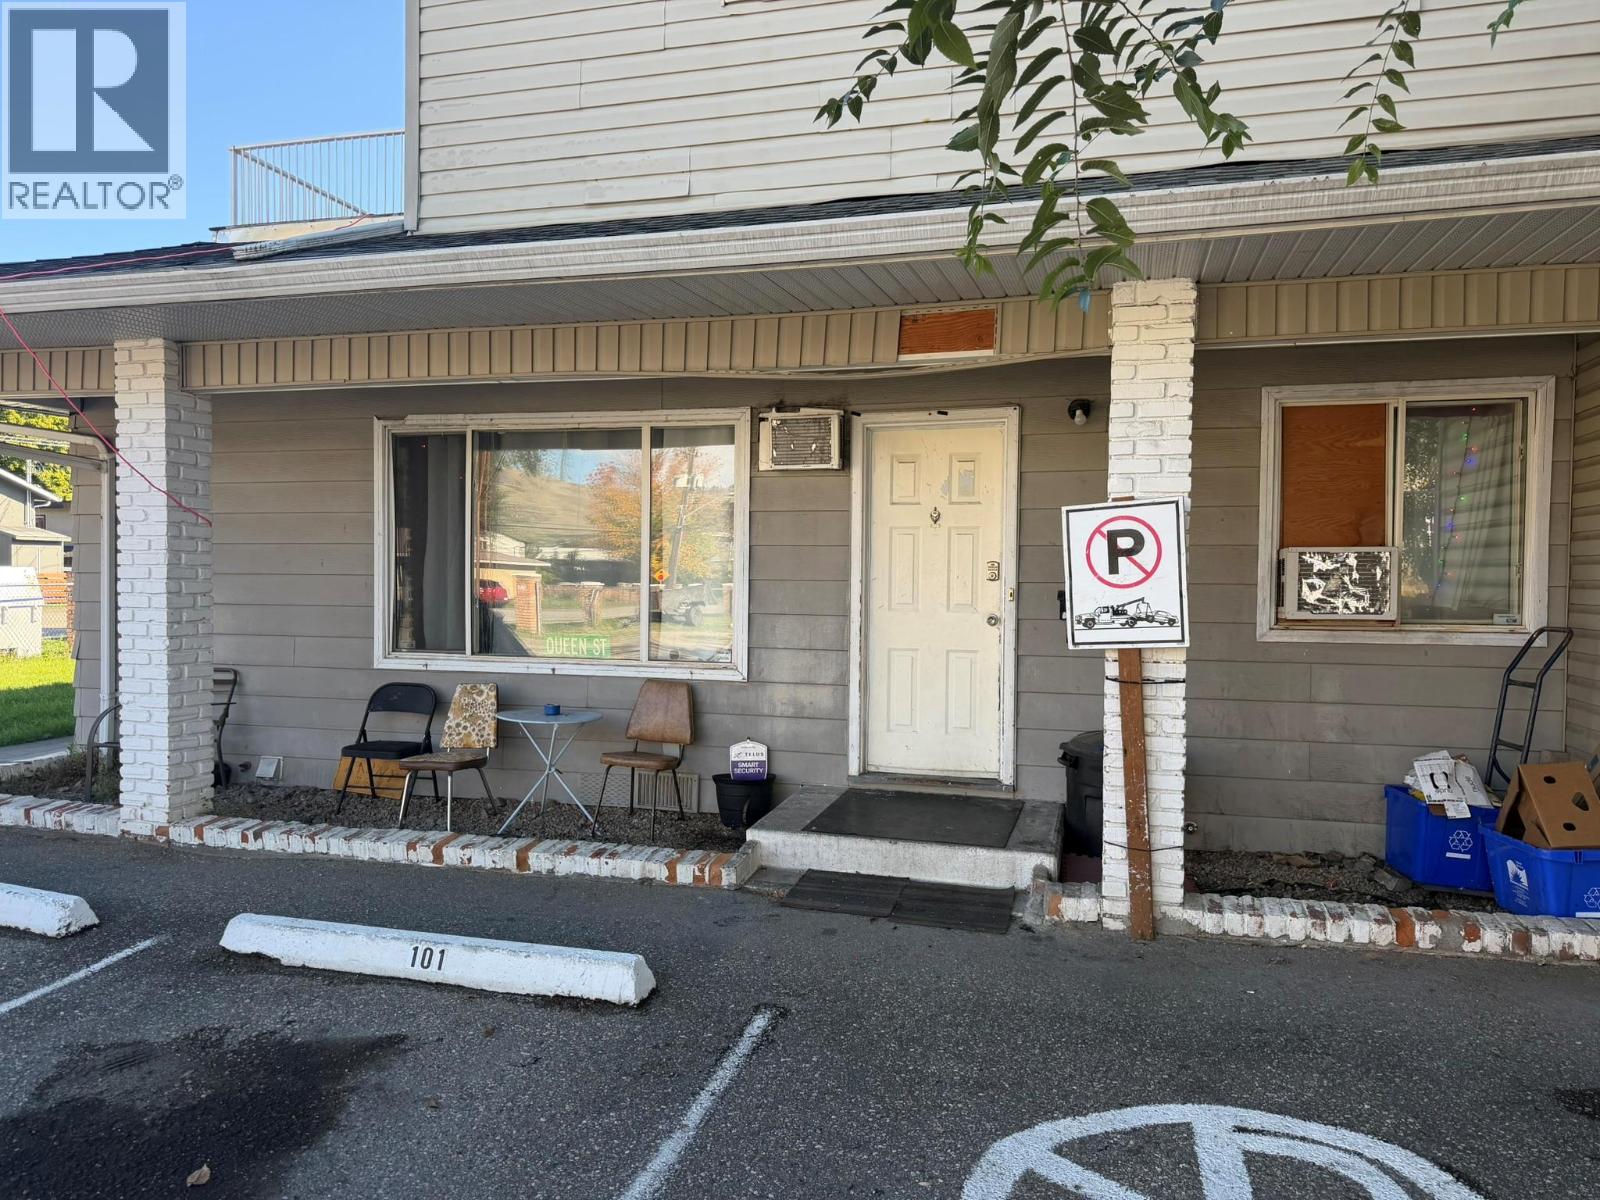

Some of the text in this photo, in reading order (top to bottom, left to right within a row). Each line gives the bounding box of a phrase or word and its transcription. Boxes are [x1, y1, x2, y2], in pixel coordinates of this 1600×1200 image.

[1106, 528, 1145, 575] P
[546, 636, 607, 656] QUEEN ST
[410, 945, 446, 971] 101
